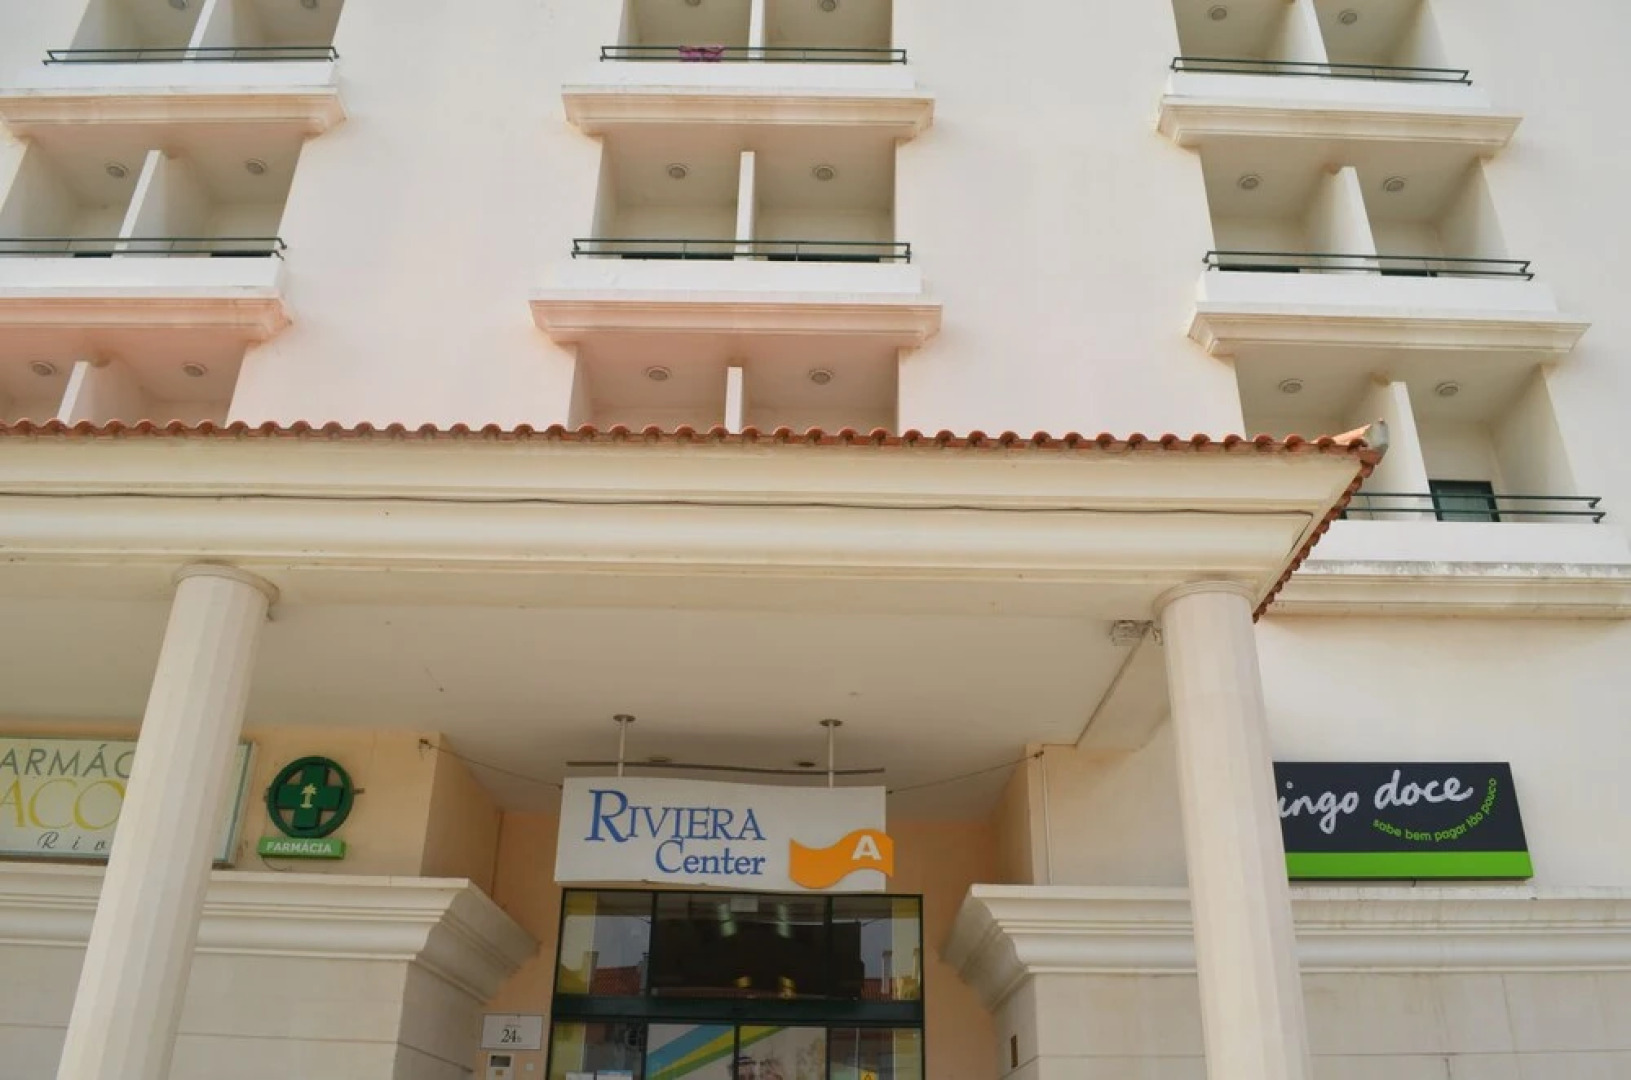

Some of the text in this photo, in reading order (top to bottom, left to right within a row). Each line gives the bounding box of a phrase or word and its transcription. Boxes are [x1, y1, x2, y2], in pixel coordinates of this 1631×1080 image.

[1374, 769, 1474, 809] doce
[1373, 819, 1401, 837] sabe
[1405, 829, 1432, 841] bem
[1435, 824, 1467, 842] pagar
[1481, 777, 1497, 815] pouco
[266, 841, 332, 854] FARMÁCIA
[655, 837, 766, 875] Center
[852, 835, 882, 861] A
